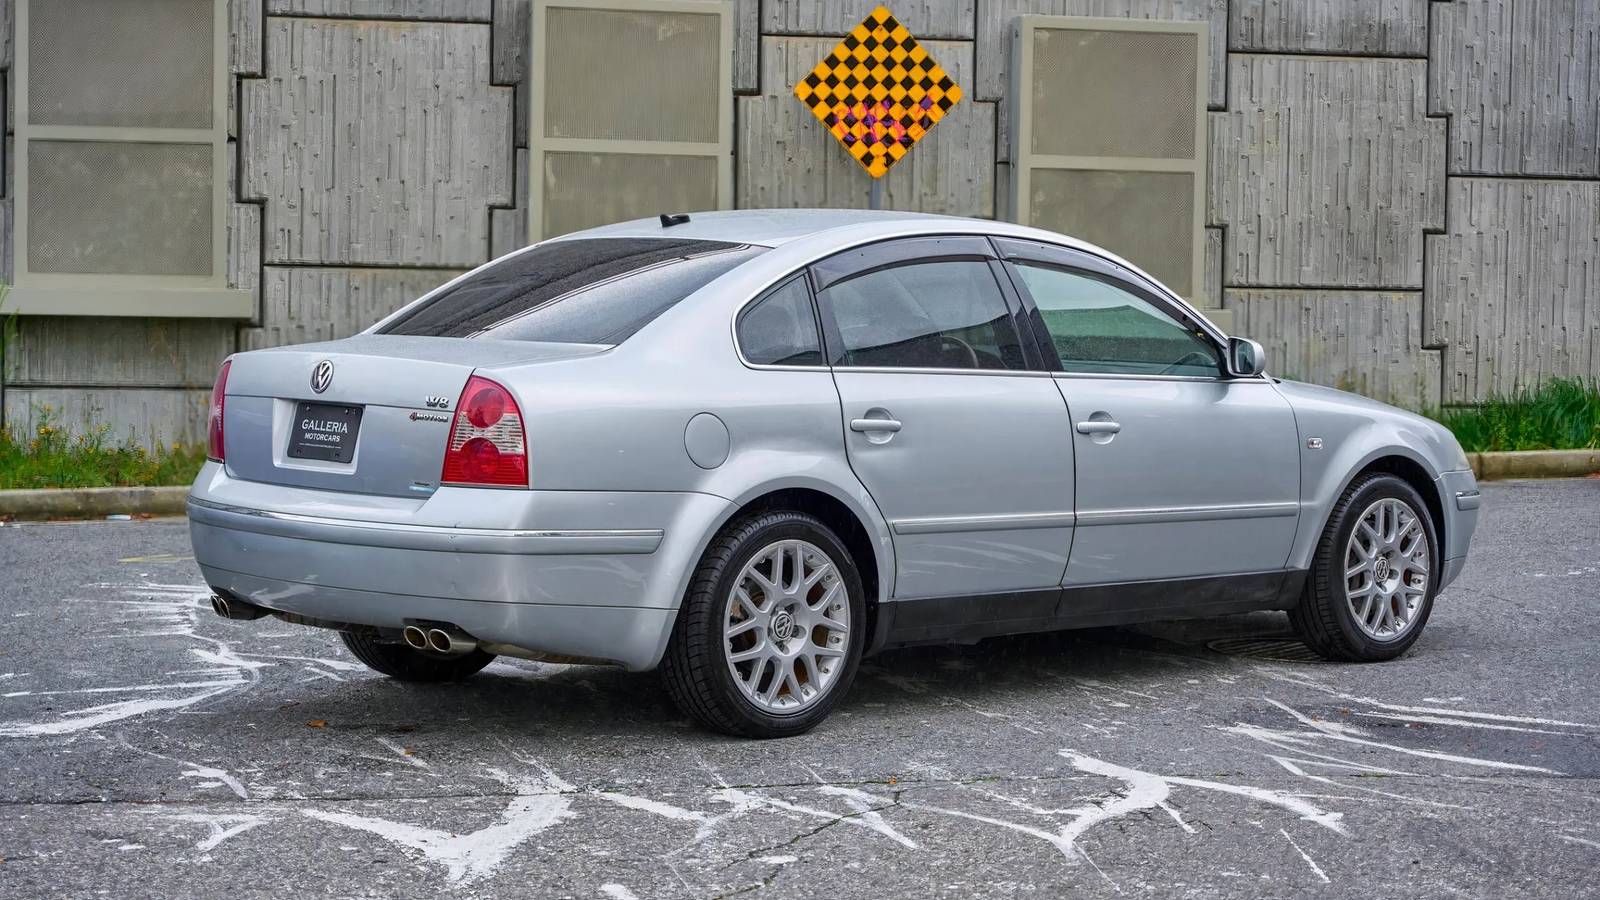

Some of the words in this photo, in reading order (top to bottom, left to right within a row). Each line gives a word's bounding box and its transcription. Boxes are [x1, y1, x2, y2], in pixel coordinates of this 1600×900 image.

[426, 396, 449, 408] W8
[301, 419, 348, 433] GALLERIA
[304, 432, 341, 442] MOTORCARS
